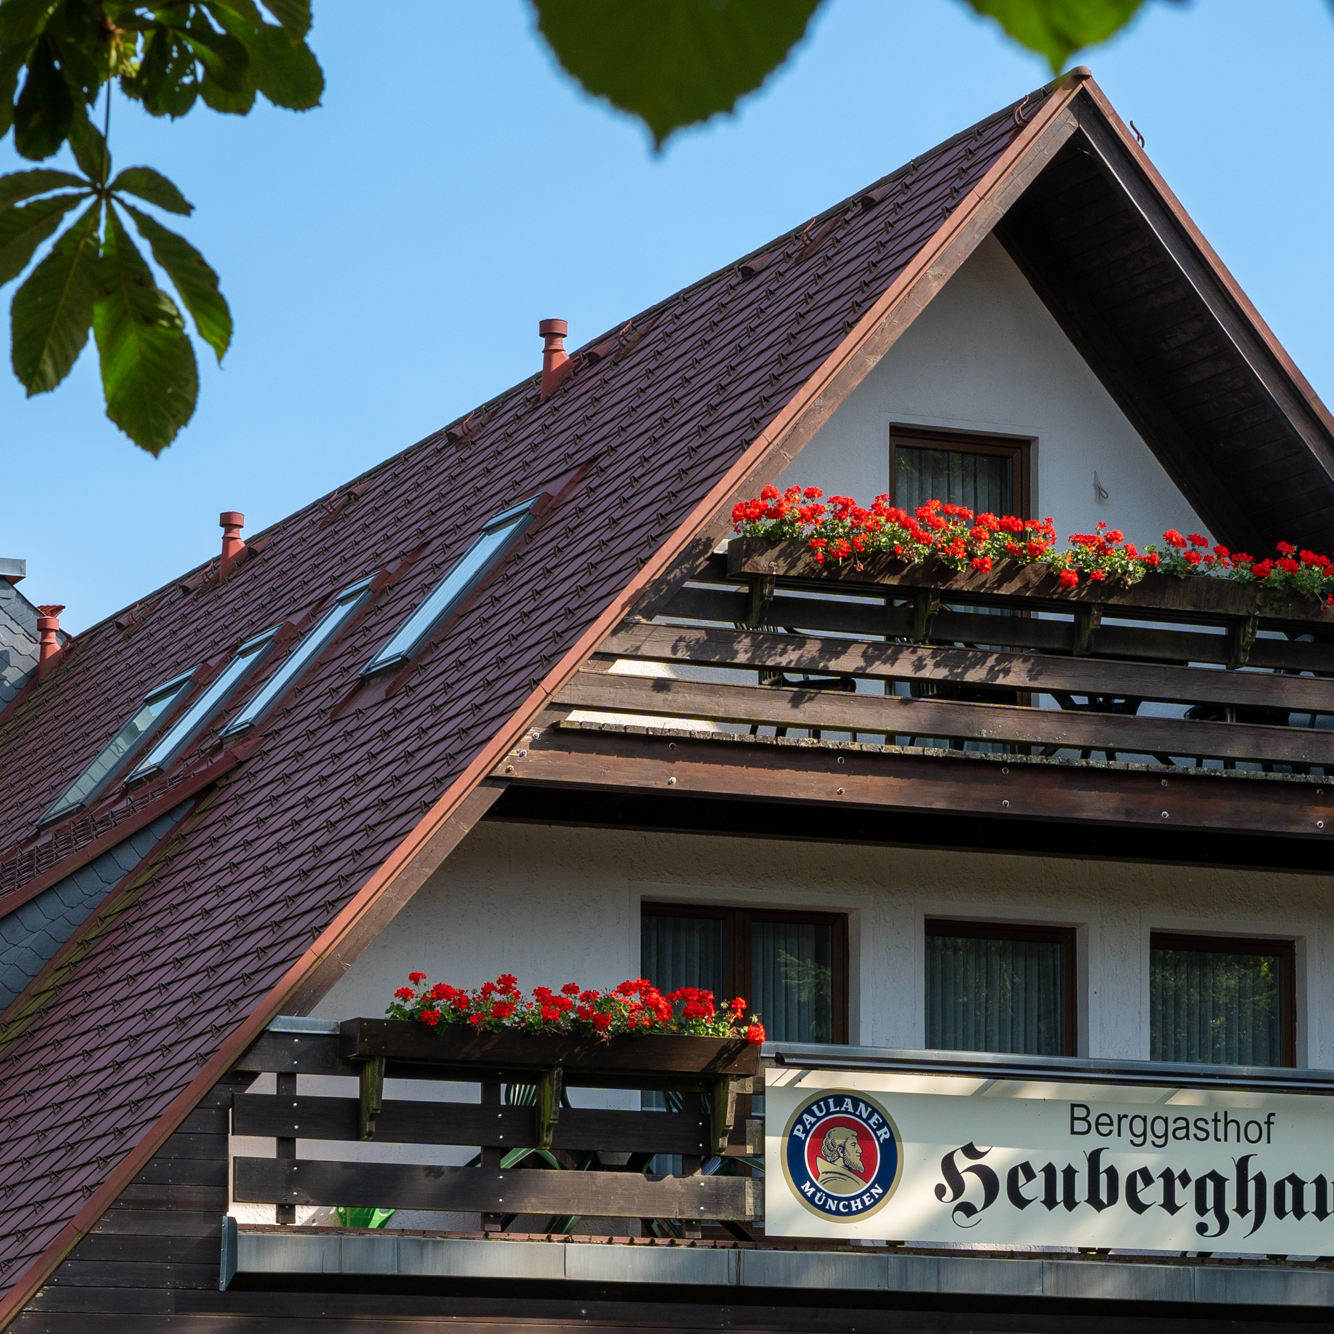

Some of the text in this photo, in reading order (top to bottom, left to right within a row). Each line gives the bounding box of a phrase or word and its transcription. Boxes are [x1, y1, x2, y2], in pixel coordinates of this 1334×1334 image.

[793, 1098, 890, 1143] PAULANER
[1070, 1103, 1275, 1147] Berggasthof
[800, 1180, 883, 1212] MÜNCHEN
